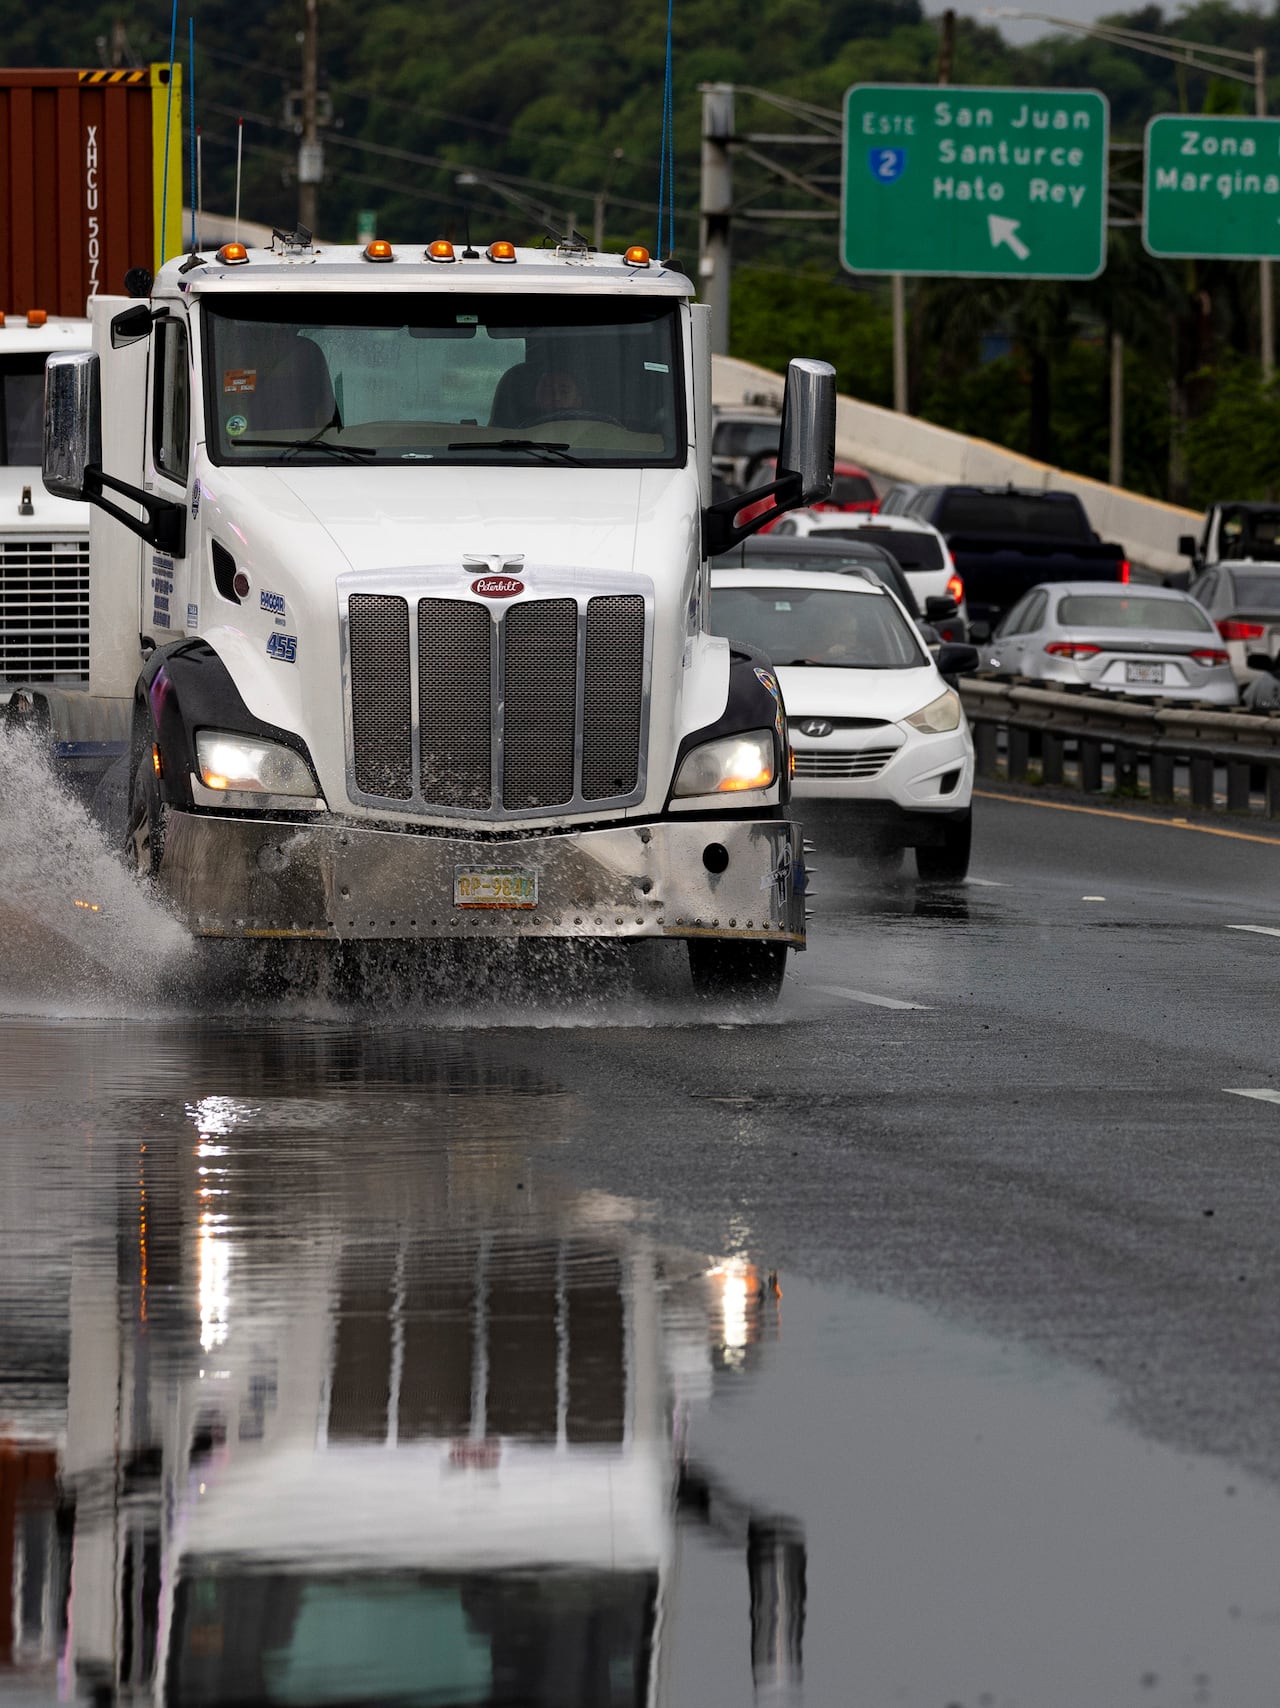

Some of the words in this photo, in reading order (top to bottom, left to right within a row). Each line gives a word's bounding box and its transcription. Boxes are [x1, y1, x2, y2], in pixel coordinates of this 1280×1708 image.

[934, 101, 994, 128] San
[1011, 104, 1091, 130] Juan
[938, 138, 1084, 167] Santurce
[1181, 130, 1256, 156] Zona
[86, 125, 98, 210] XHCU
[878, 149, 898, 177] 2
[933, 175, 1005, 202] Hato
[1029, 177, 1087, 208] Rey
[477, 579, 521, 593] Peterbilt
[266, 632, 298, 664] 455
